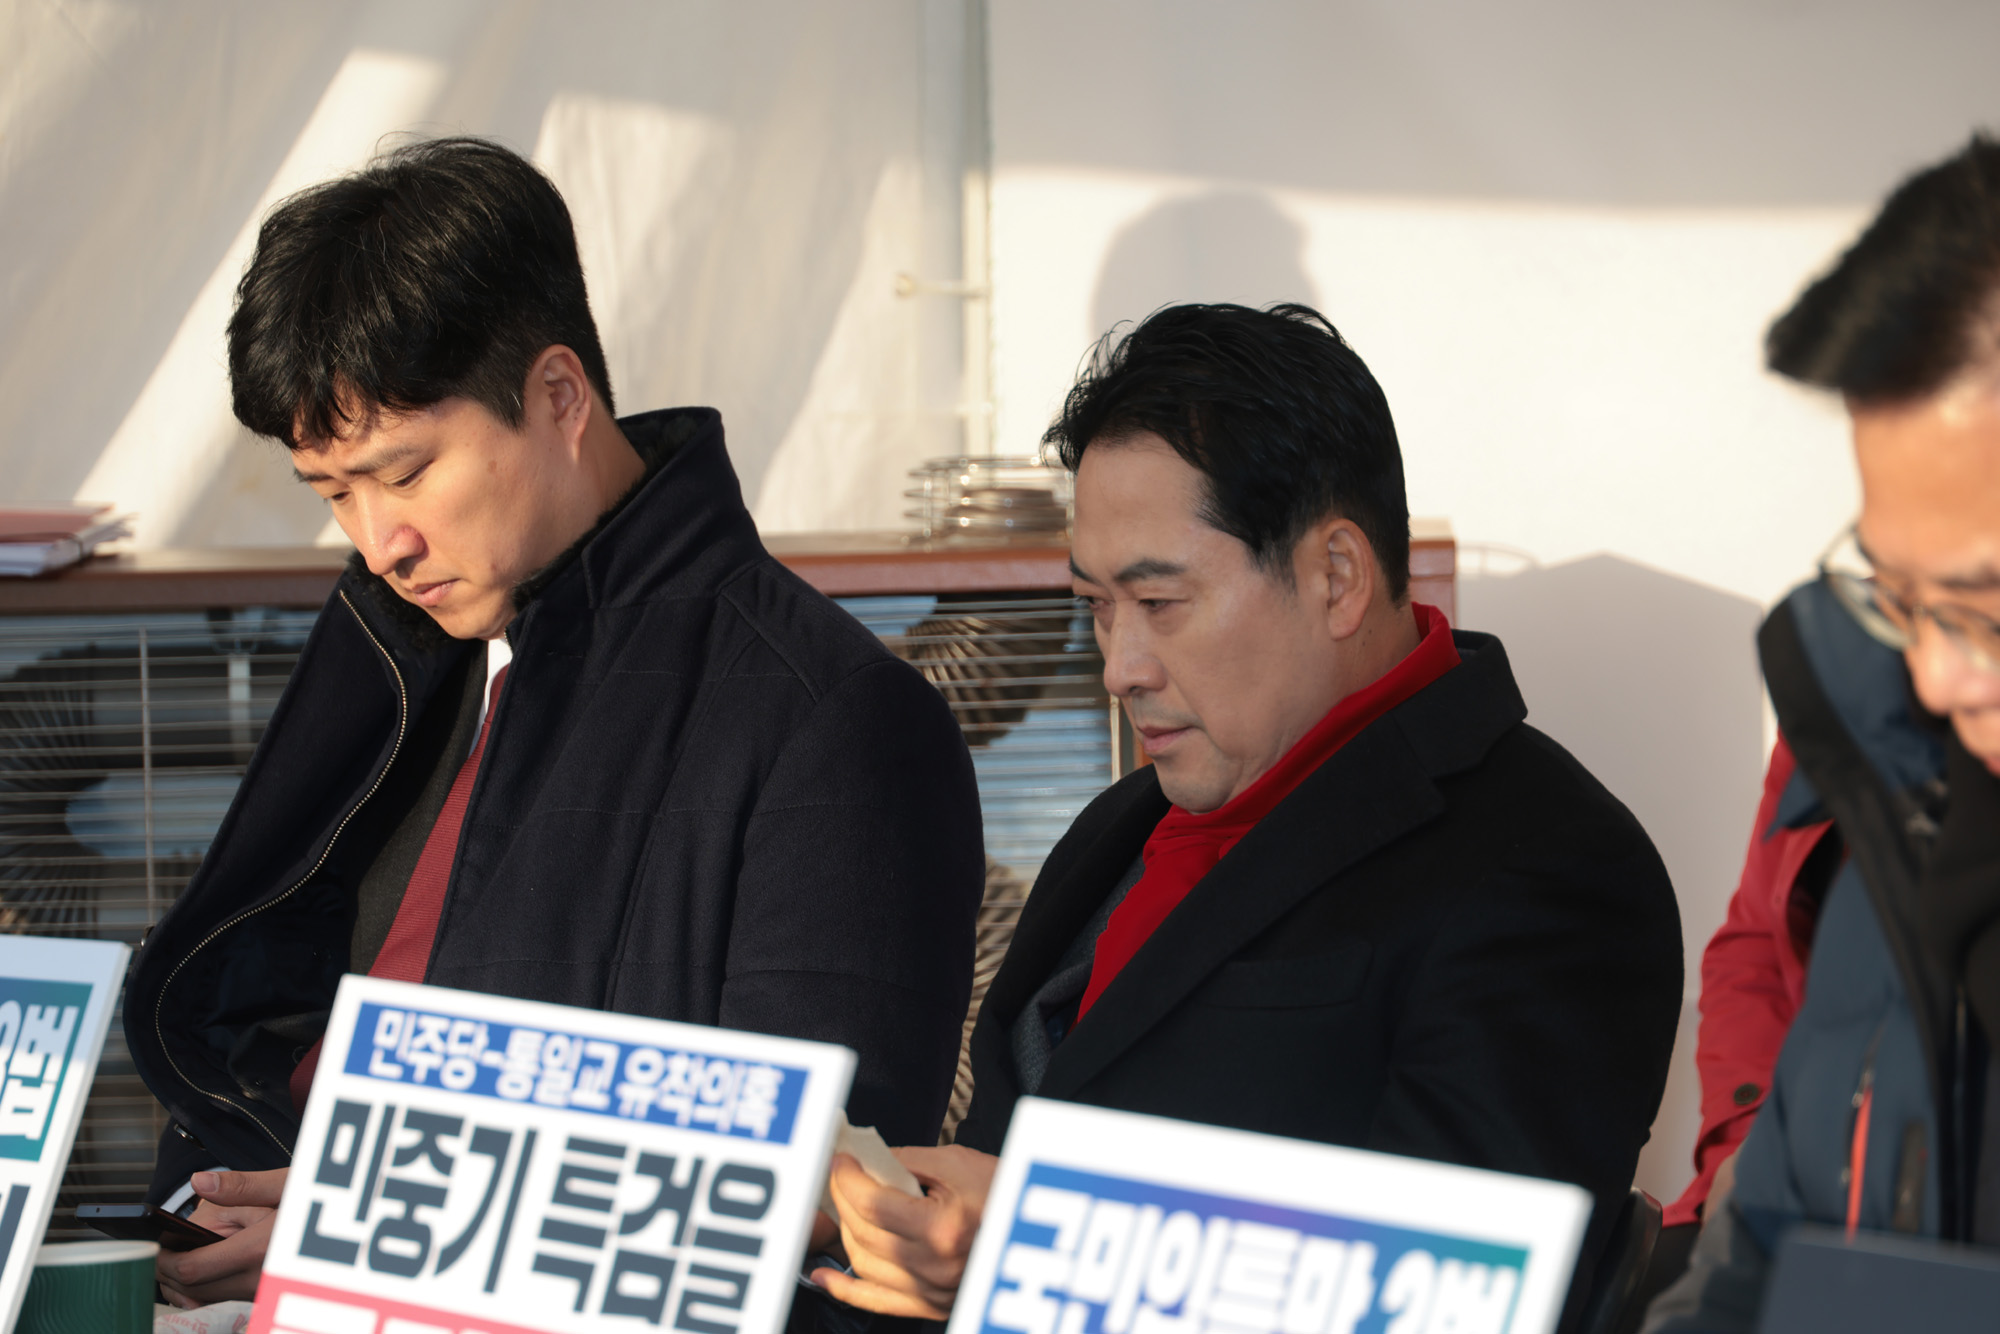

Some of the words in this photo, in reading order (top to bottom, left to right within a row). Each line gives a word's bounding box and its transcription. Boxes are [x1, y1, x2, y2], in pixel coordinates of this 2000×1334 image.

[369, 1008, 621, 1110] 민주당-통일교
[615, 1047, 785, 1139] 유착의혹
[297, 1097, 539, 1293] 민중기
[531, 1136, 778, 1334] 특검을
